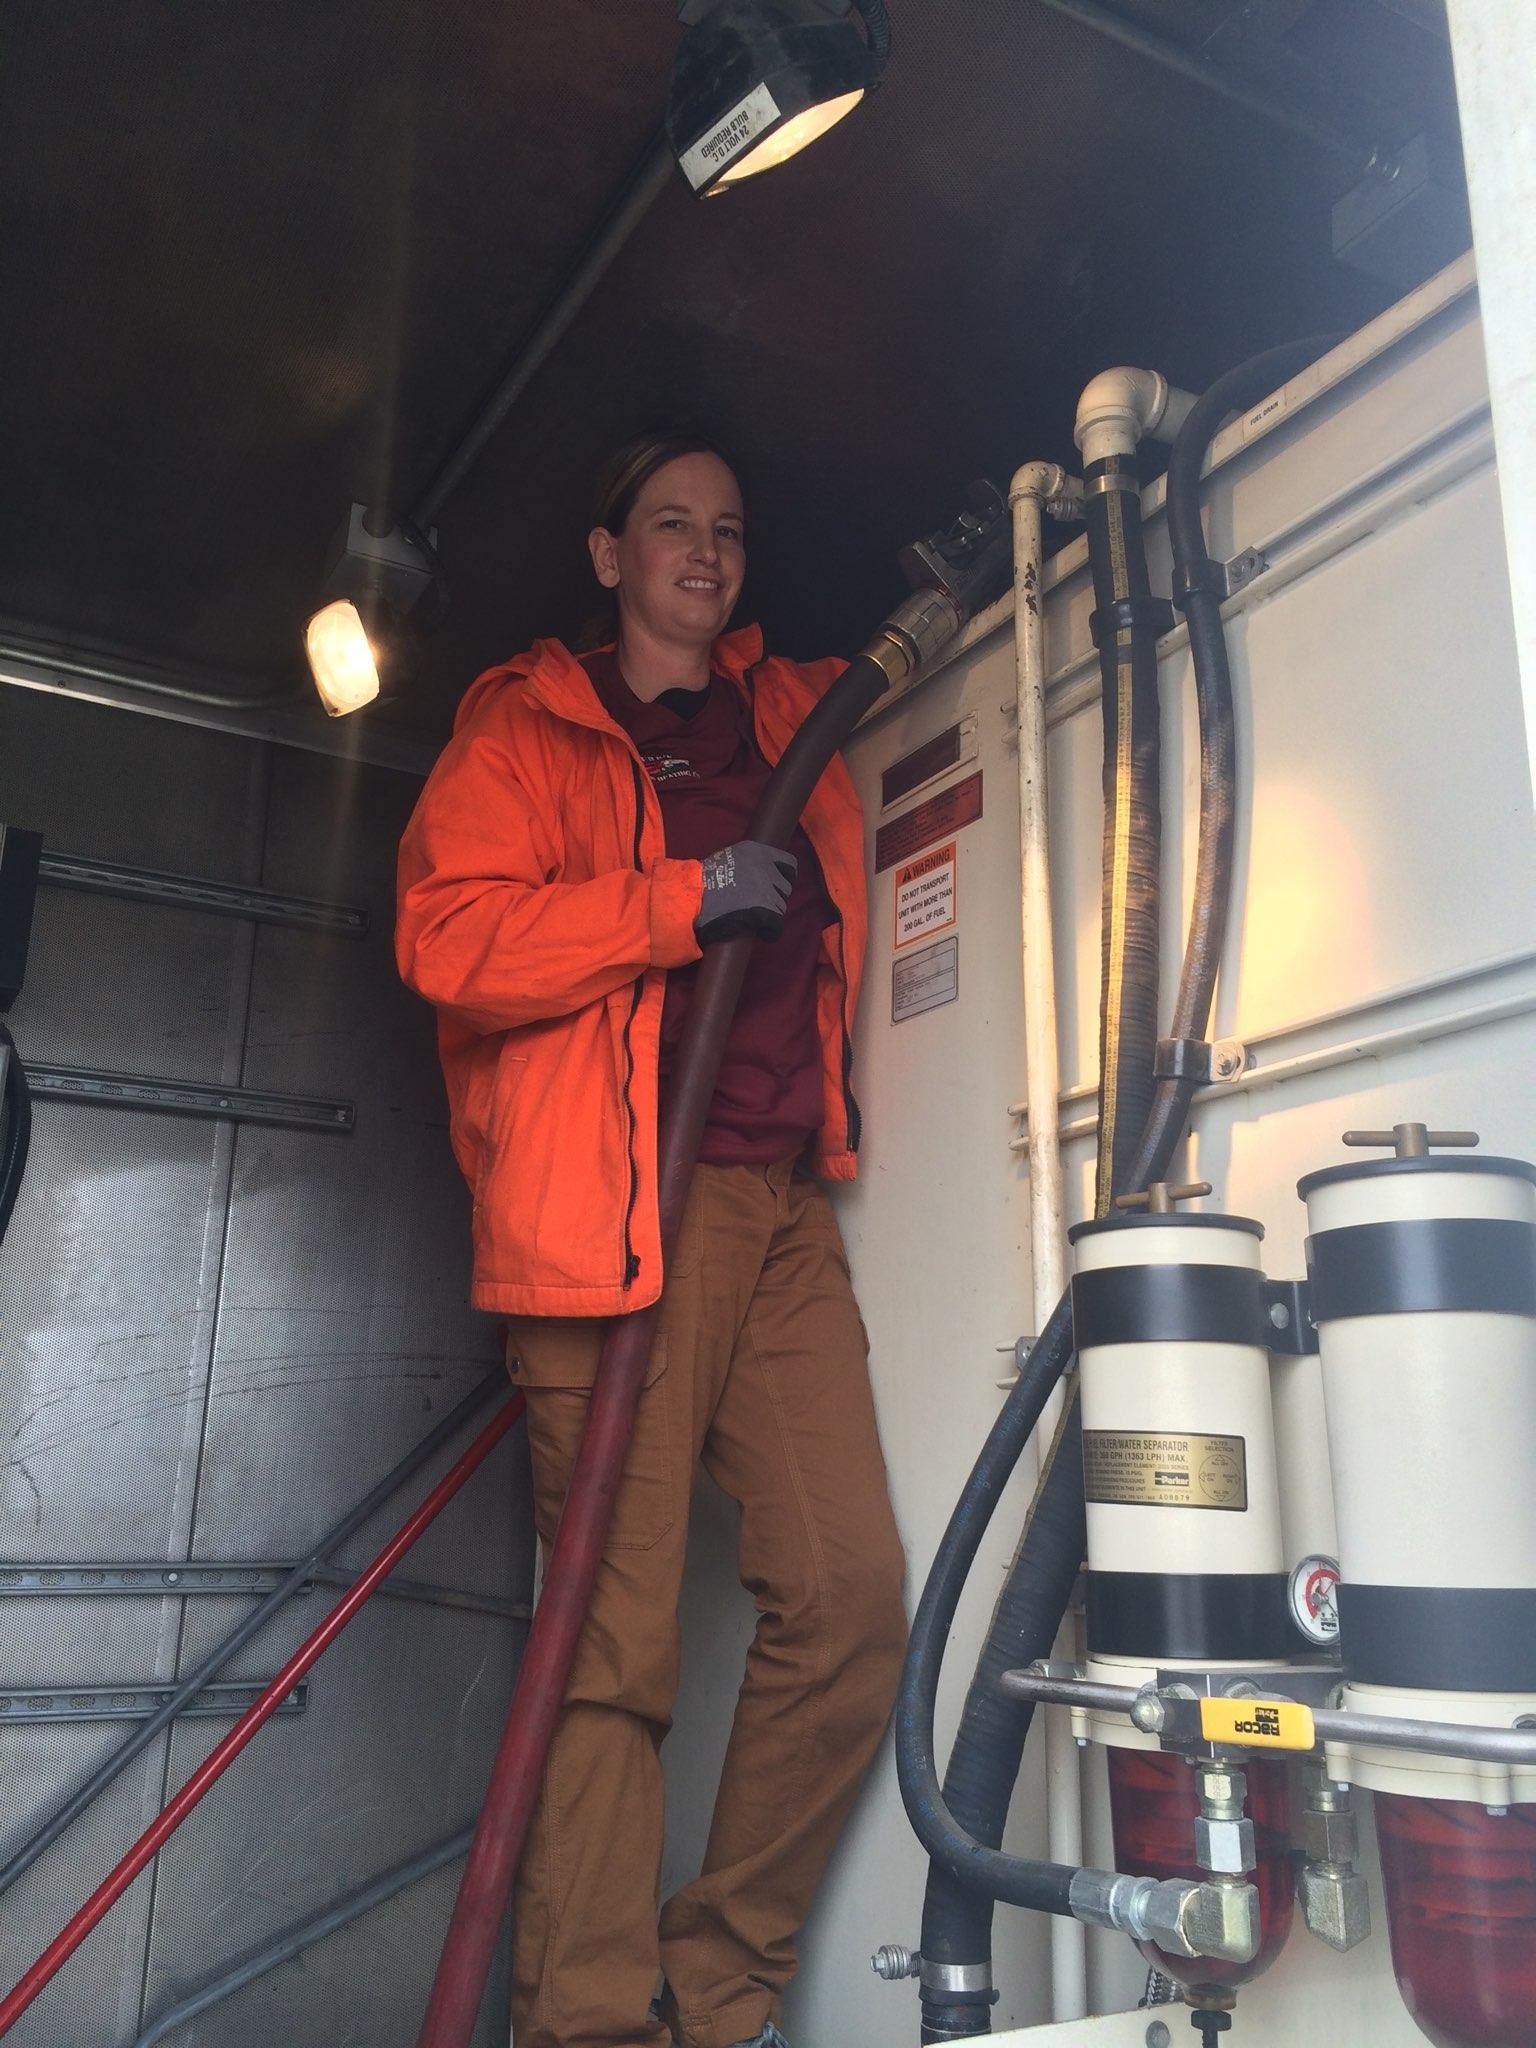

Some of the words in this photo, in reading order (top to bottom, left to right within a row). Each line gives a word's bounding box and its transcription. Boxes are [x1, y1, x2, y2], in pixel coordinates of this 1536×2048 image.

[730, 110, 749, 131] BULB
[739, 125, 749, 138] 24
[701, 126, 732, 158] REQUIRED
[724, 133, 741, 152] VOLT
[1250, 413, 1262, 426] FUEL
[1263, 401, 1279, 416] DRAIN
[912, 848, 951, 878] WARNING
[901, 892, 909, 902] DO
[909, 887, 920, 900] NOT
[920, 872, 950, 894] TRANSPORT
[898, 907, 910, 920] UNIT
[910, 900, 923, 914] WITH
[923, 893, 938, 908] MORE
[939, 886, 953, 900] THAN
[925, 911, 933, 922] OF
[933, 906, 946, 920] FUEL
[1143, 1440, 1189, 1451] SEPARATOR
[1110, 1452, 1122, 1460] GPH
[1125, 1453, 1145, 1461] (1363
[1146, 1453, 1165, 1462] LPH)
[1160, 1475, 1189, 1485] Parker
